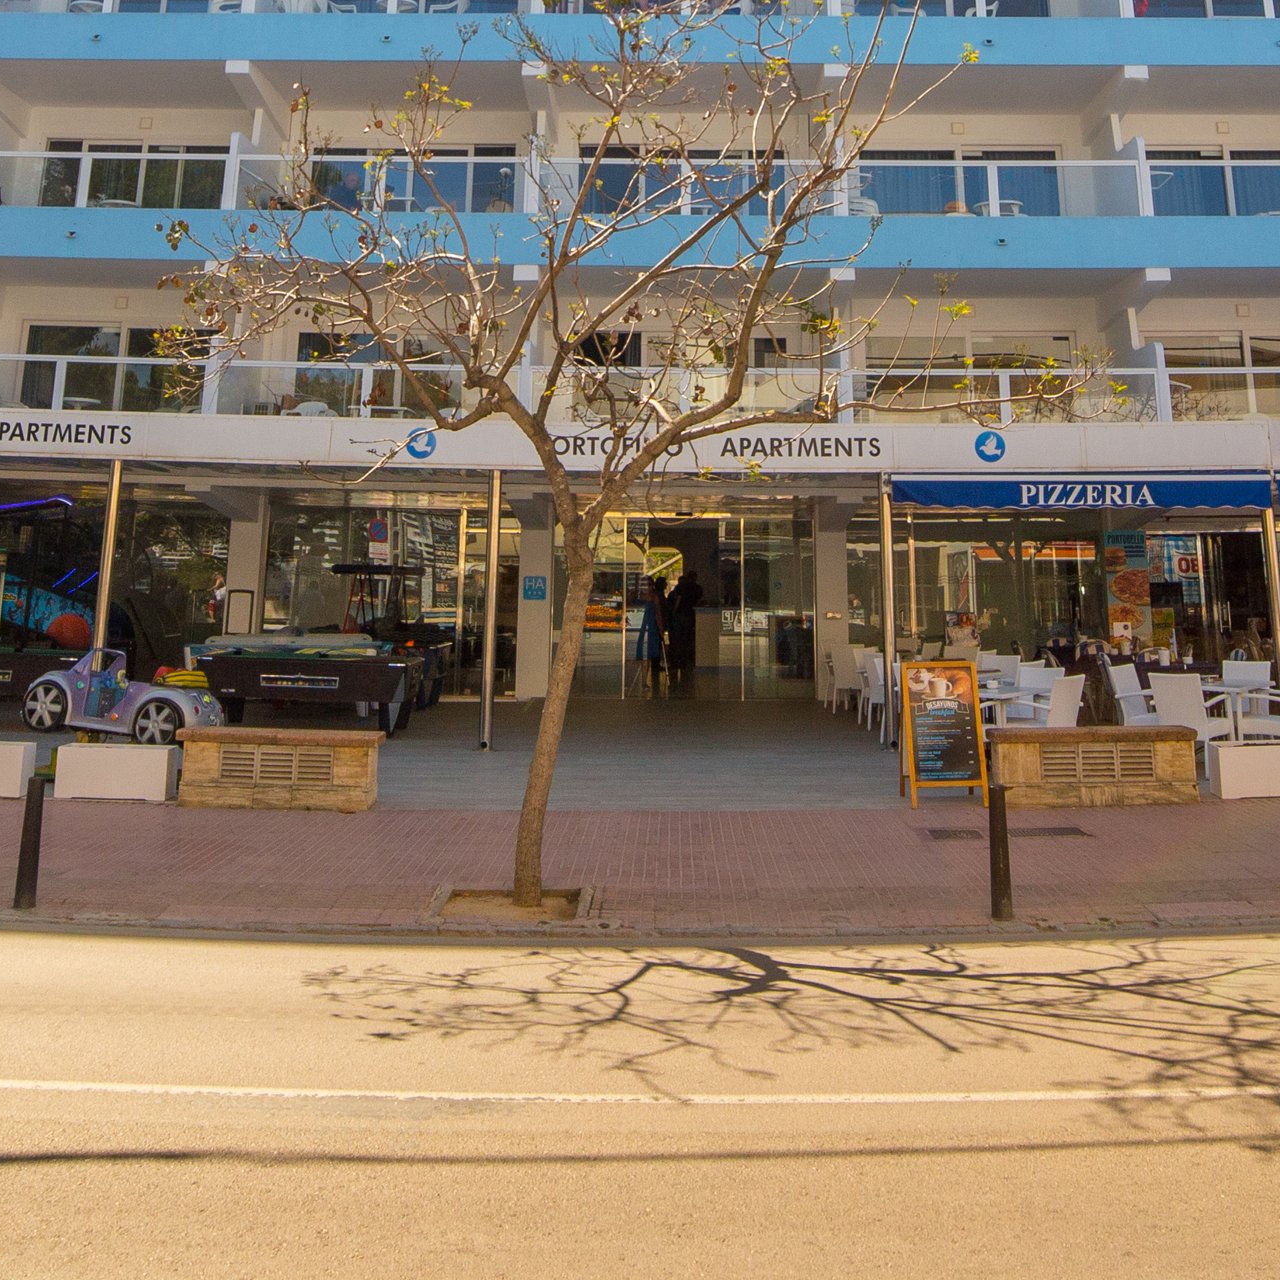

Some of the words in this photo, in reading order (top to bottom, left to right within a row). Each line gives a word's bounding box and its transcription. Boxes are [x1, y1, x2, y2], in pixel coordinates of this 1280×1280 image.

[720, 436, 881, 458] APARTMENTS
[1020, 482, 1154, 507] PIZZERIA
[525, 578, 545, 590] HA
